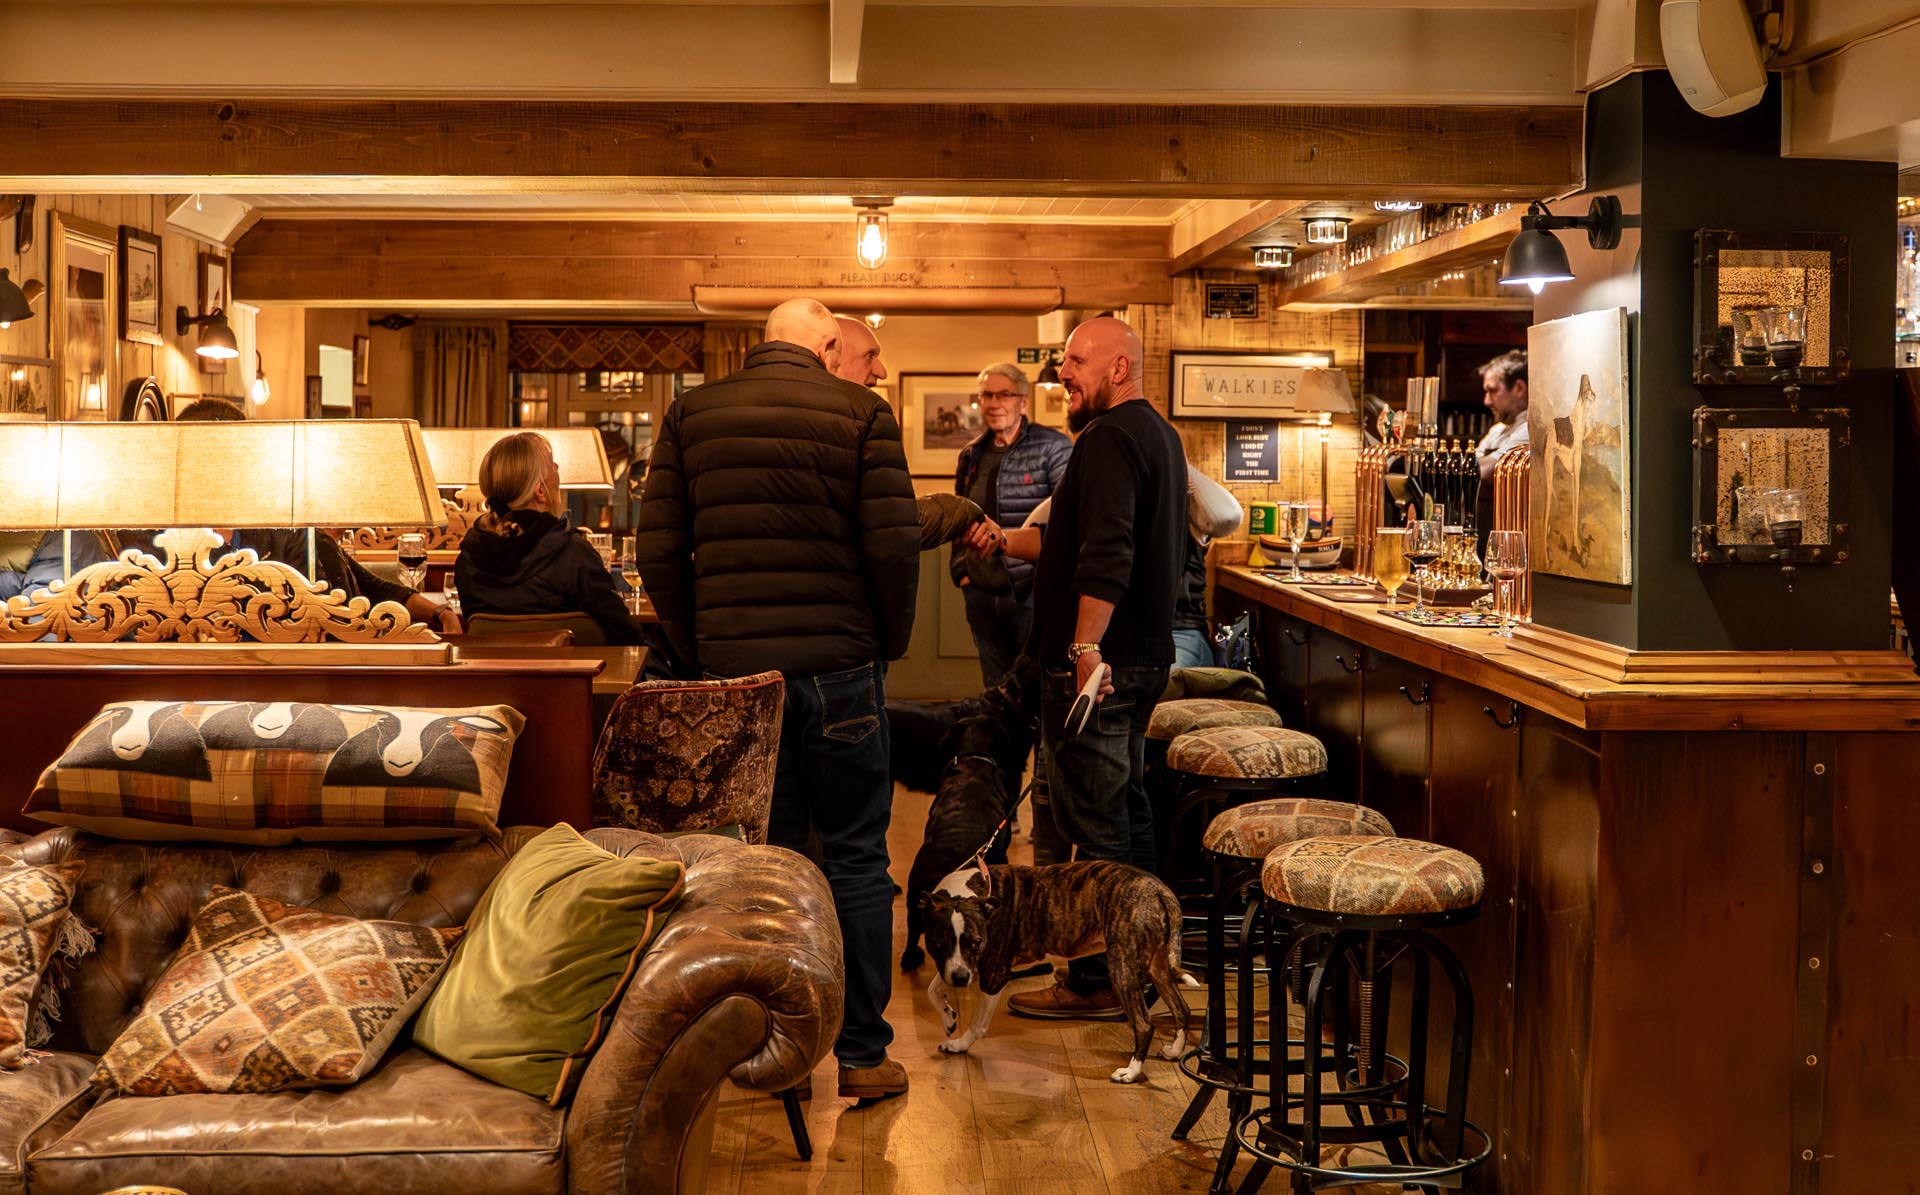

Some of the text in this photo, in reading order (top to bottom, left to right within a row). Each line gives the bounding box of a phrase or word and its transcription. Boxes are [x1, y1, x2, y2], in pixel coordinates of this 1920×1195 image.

[840, 272, 916, 282] PLEASE DUCK
[1205, 378, 1297, 395] WALKIES
